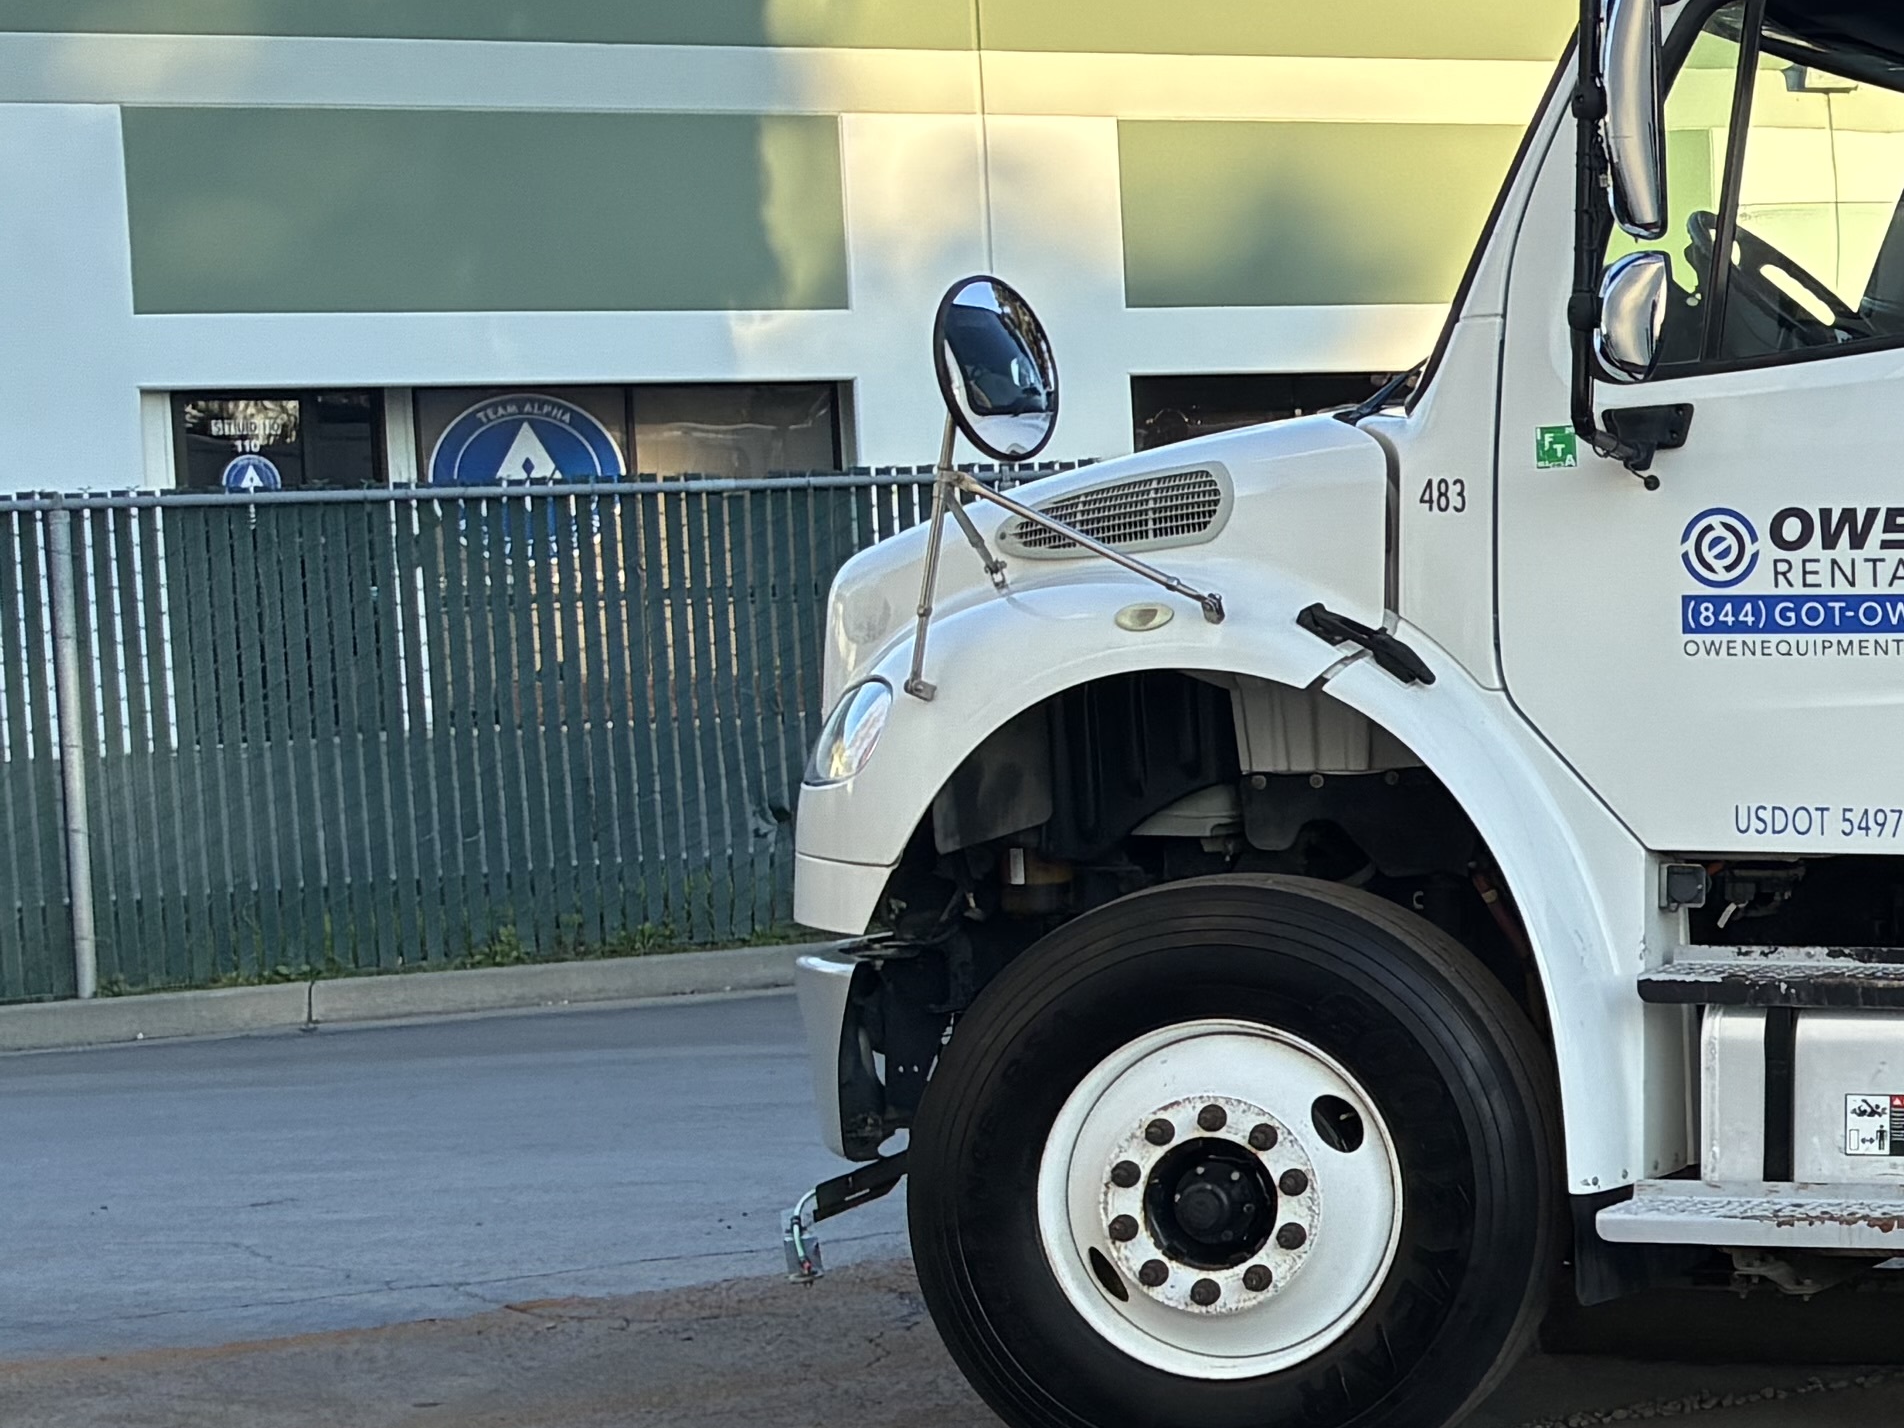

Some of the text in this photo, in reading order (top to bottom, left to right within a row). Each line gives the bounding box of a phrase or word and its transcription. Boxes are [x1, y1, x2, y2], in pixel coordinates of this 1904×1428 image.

[476, 402, 572, 424] TEAM ALPHA
[211, 419, 282, 436] STUDIO
[235, 439, 261, 453] 110
[1418, 477, 1467, 513] 483
[1686, 599, 1767, 630] (844)
[1734, 804, 1831, 837] USDOT
